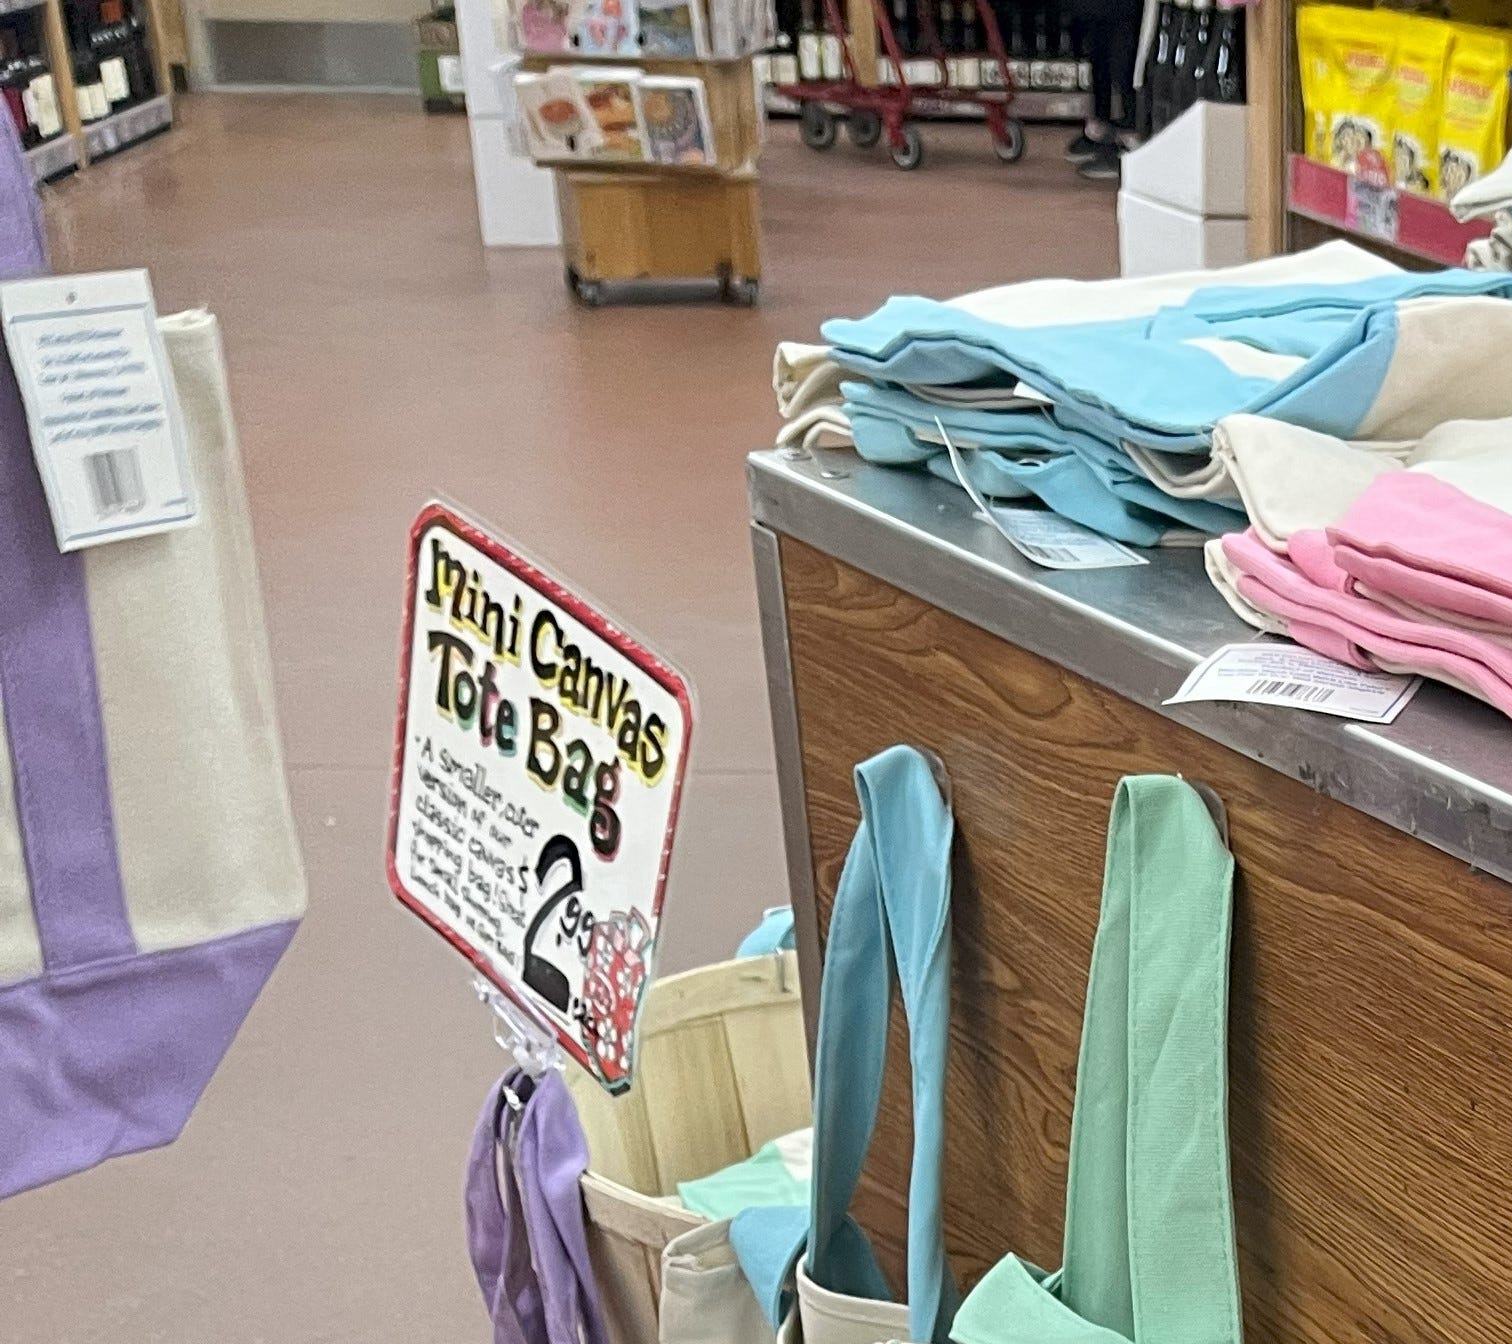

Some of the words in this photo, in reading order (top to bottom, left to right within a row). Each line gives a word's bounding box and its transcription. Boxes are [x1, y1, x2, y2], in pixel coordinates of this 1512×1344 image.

[427, 630, 520, 758] Tote
[526, 696, 622, 863] Bag
[530, 609, 668, 786] Canvas
